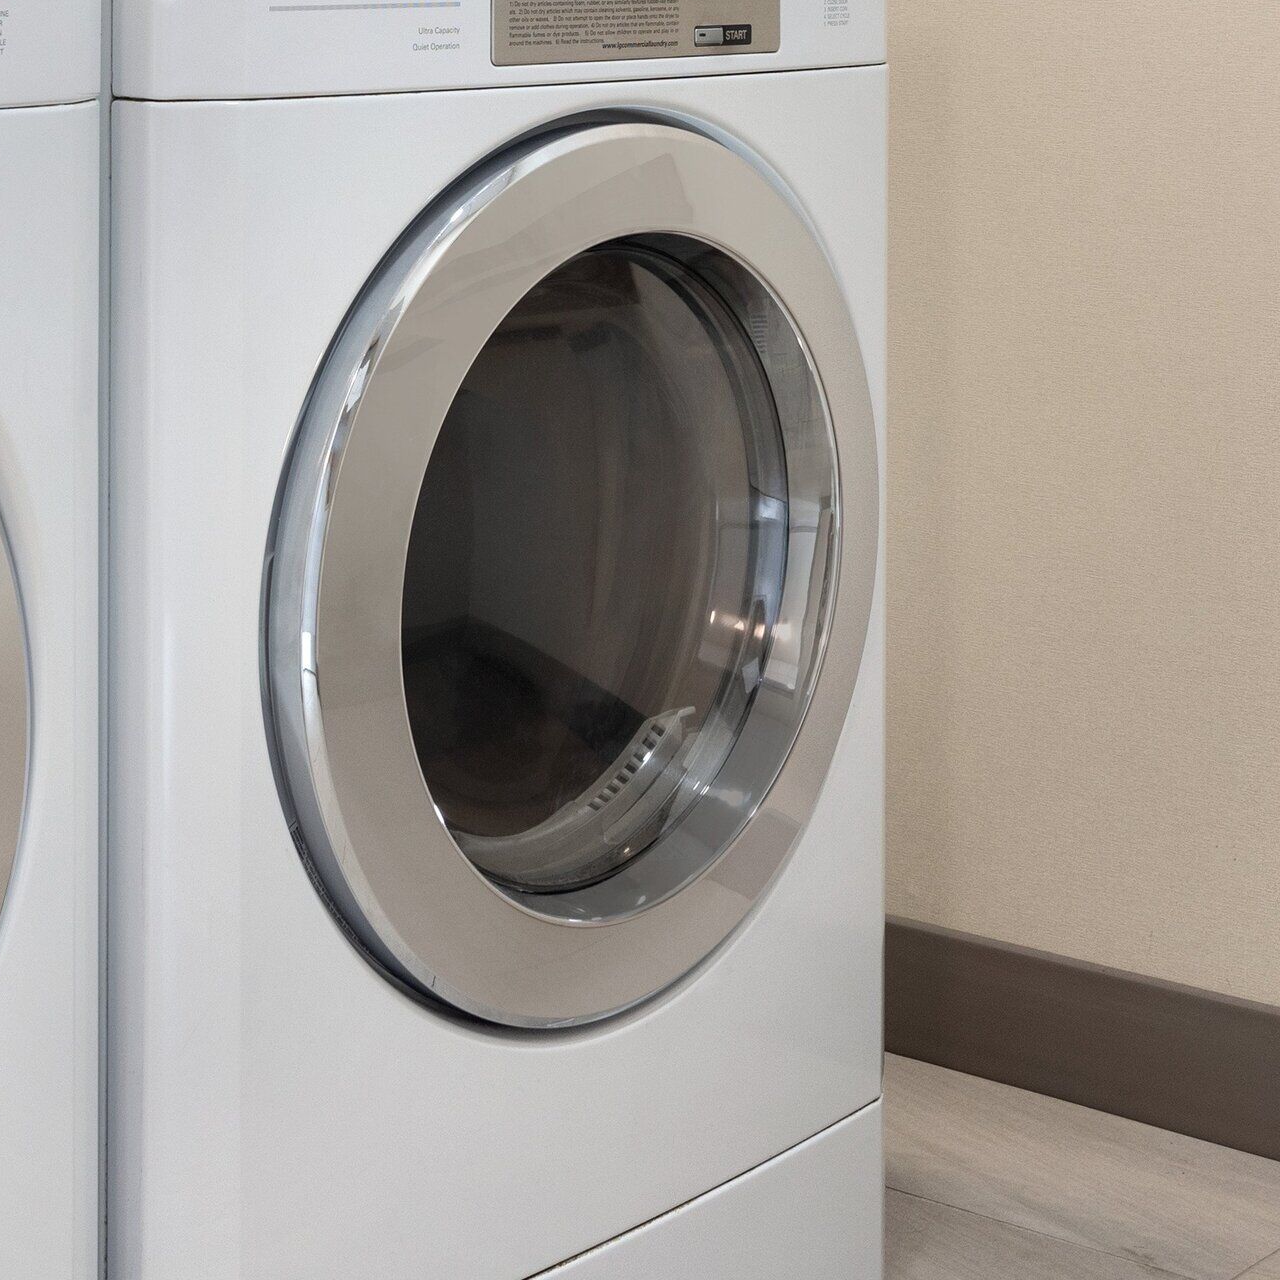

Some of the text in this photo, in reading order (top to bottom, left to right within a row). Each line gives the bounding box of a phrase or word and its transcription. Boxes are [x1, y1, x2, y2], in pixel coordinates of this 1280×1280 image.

[418, 26, 460, 36] Ultra Capacity
[725, 30, 747, 40] START
[430, 42, 460, 52] Operation
